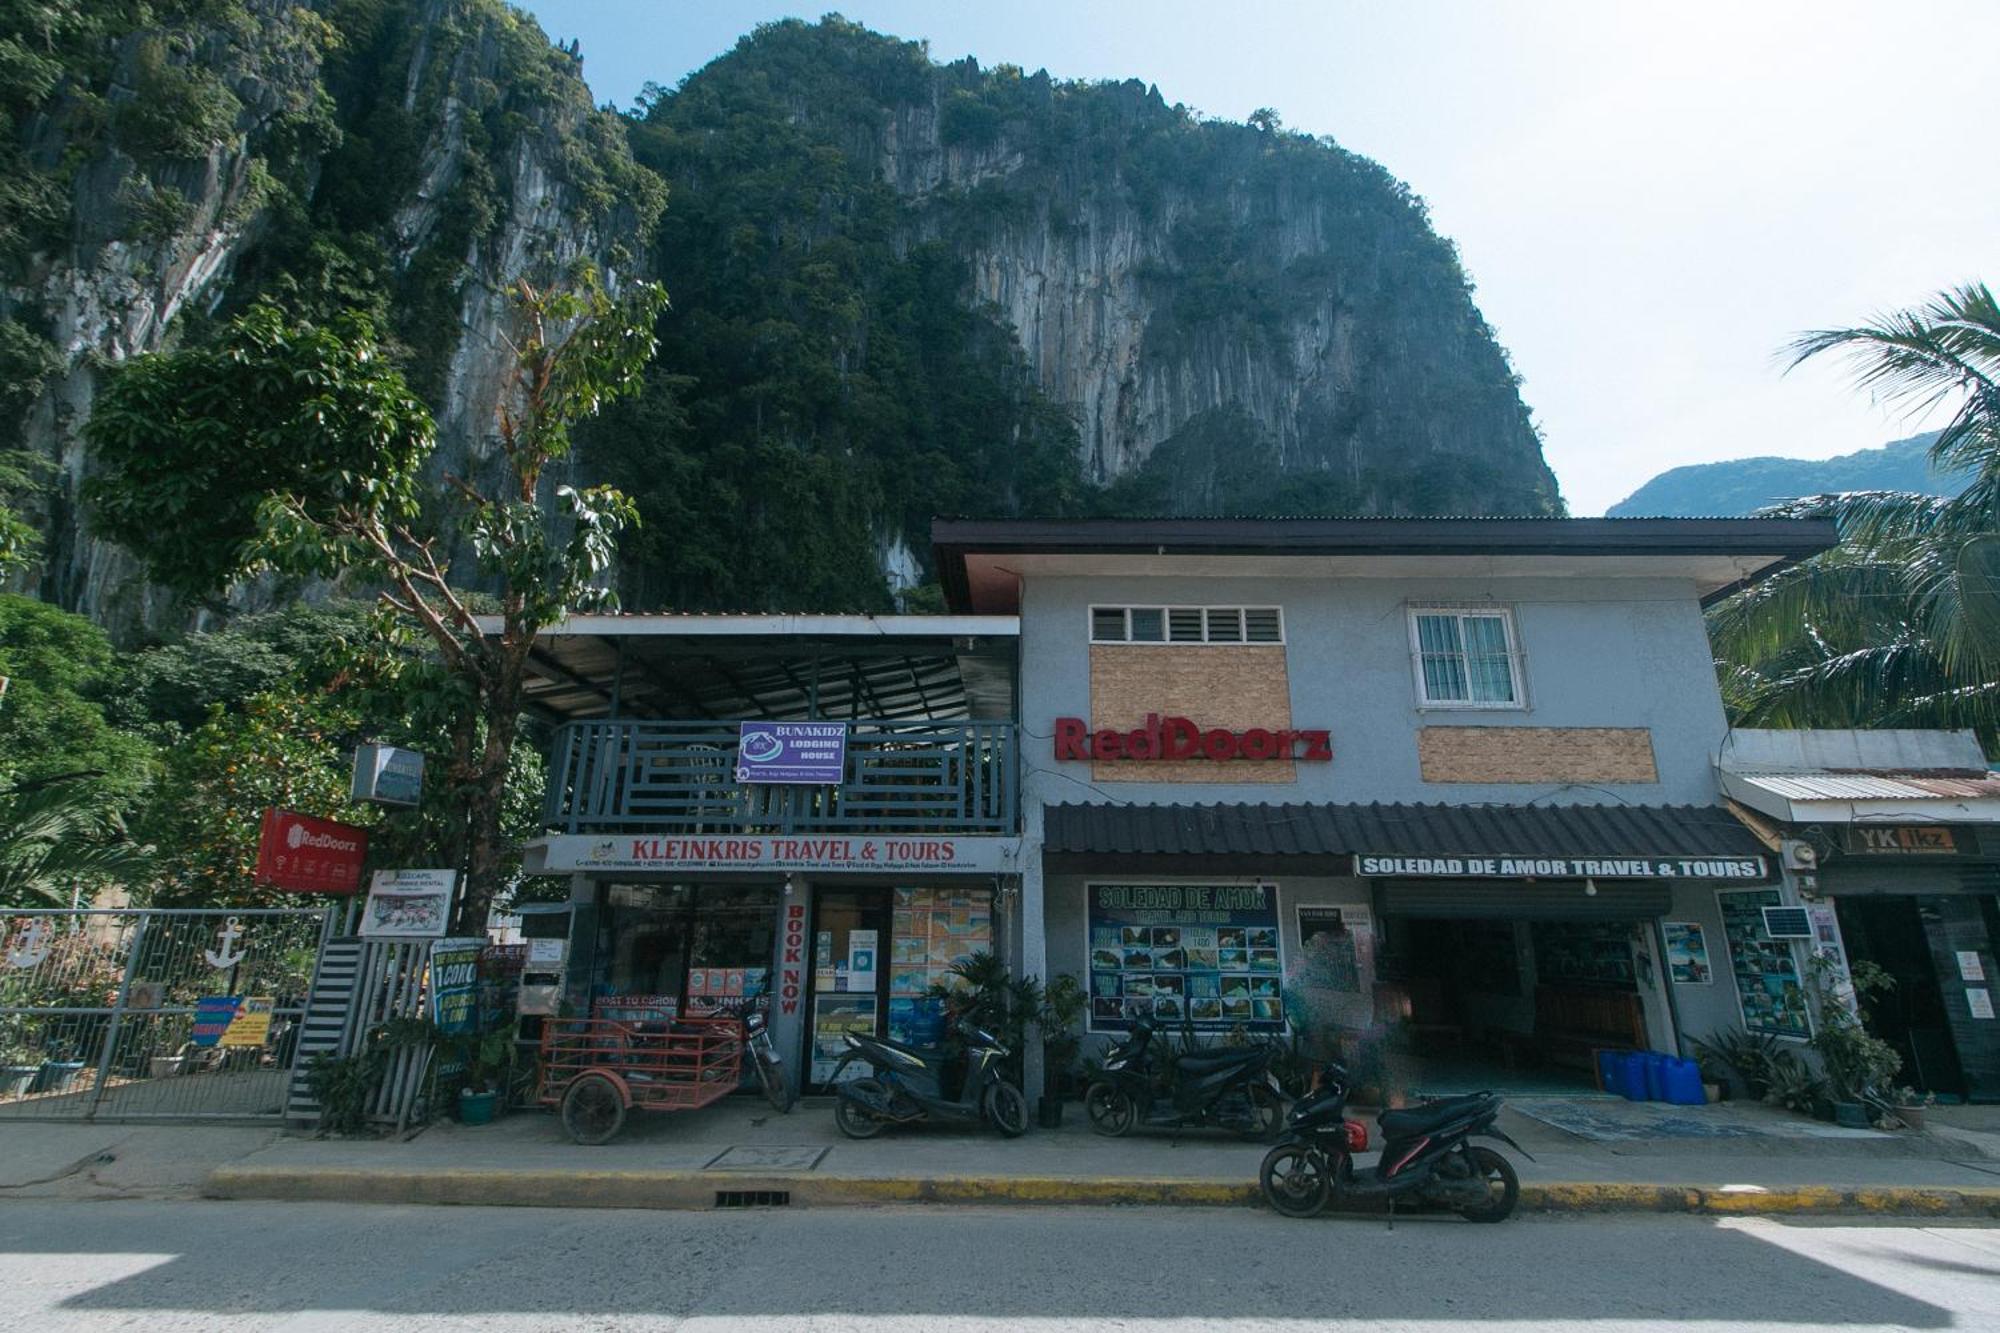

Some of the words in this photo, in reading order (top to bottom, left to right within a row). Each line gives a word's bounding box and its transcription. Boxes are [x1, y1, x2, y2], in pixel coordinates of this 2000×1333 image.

[775, 726, 844, 737] BUNAKIDZ
[1055, 713, 1333, 762] RedDoorz
[789, 740, 840, 749] LODGING
[800, 751, 836, 760] HOUSE
[302, 831, 357, 852] RedDoorz
[631, 840, 762, 860] KLEINKRIS
[771, 840, 856, 861] TRAVEL
[861, 841, 878, 861] &
[885, 841, 955, 861] TOURS
[1363, 858, 1463, 874] SOLEDAD
[1468, 859, 1497, 875] DE
[1500, 859, 1568, 875] AMOR
[1571, 860, 1654, 876] TRAVEL
[1658, 862, 1676, 876] &
[1678, 861, 1756, 877] TOURS
[1099, 887, 1183, 909] SOLEDAD
[1185, 887, 1212, 909] DE
[1215, 887, 1267, 910] AMOR
[785, 906, 804, 963] BOOK
[781, 970, 800, 1014] NOW
